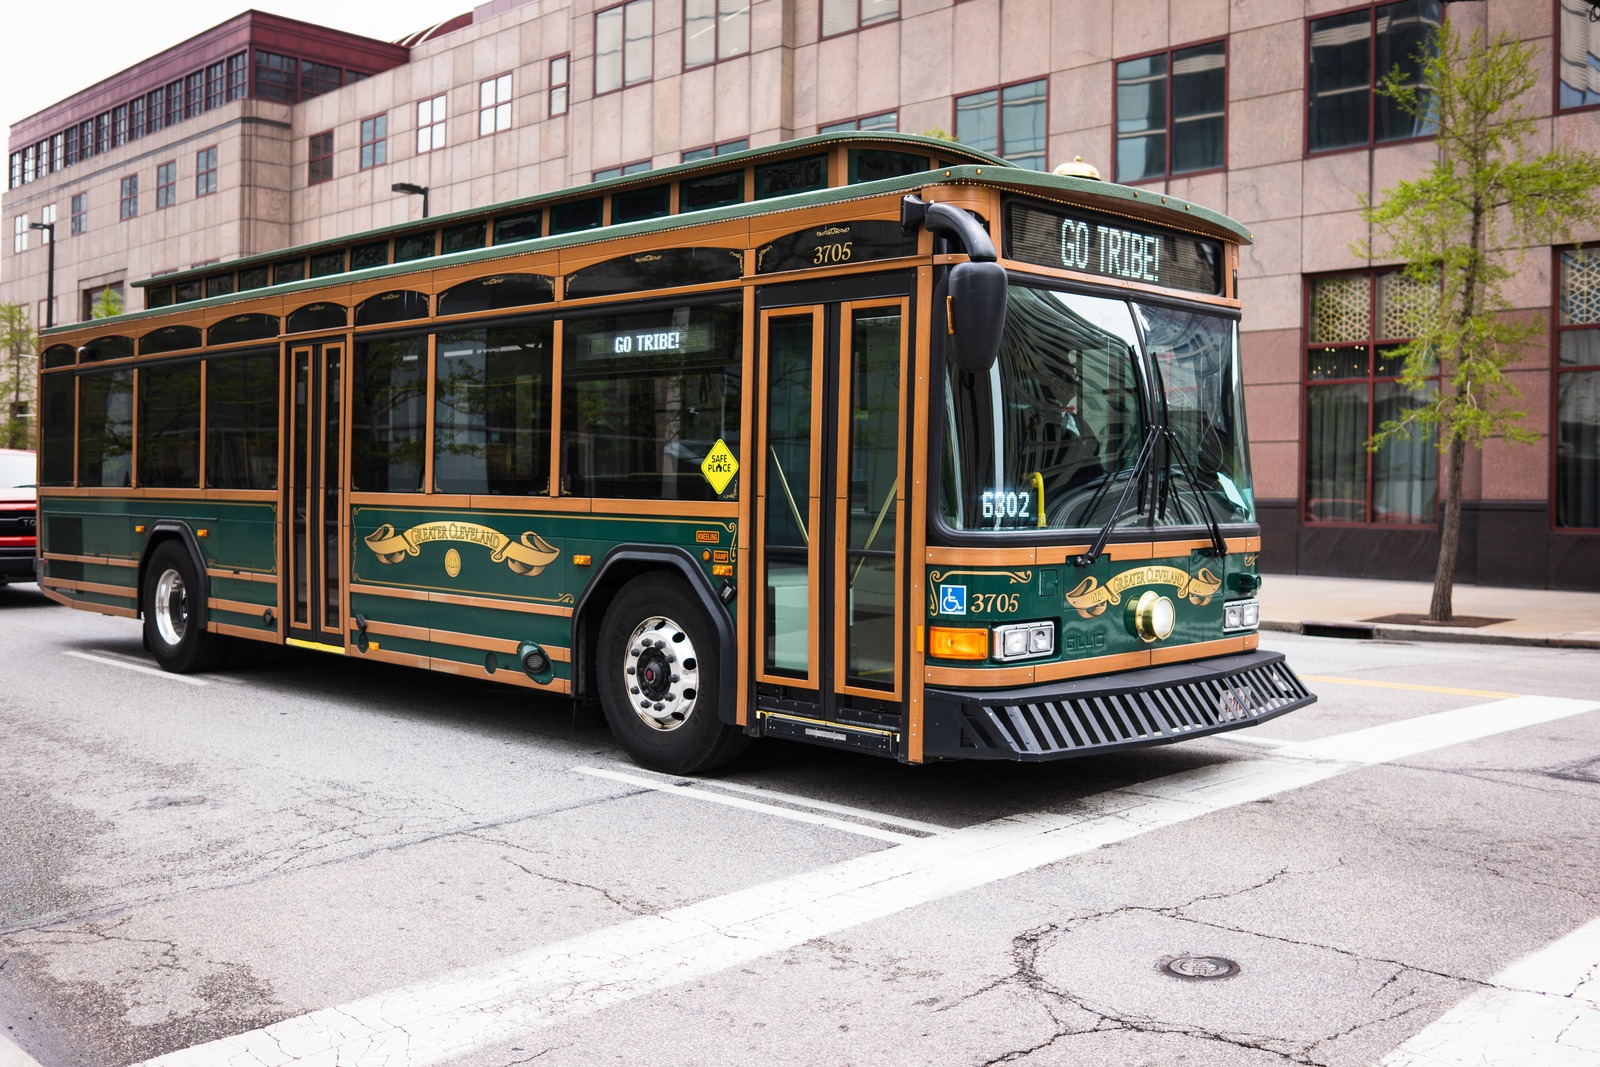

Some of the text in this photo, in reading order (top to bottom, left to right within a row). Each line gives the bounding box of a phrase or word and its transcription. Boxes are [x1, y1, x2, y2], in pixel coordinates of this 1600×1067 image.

[813, 241, 853, 265] 3705
[1061, 219, 1160, 282] GO TRIBE!
[615, 331, 680, 353] GO TRIBE!
[711, 454, 727, 463] SAFE
[982, 491, 1030, 518] 6302
[411, 523, 500, 549] GREATER CLEVELAND
[1113, 570, 1146, 593] GREATER
[1146, 567, 1185, 587] CLEVELAND
[970, 593, 1020, 613] 3705
